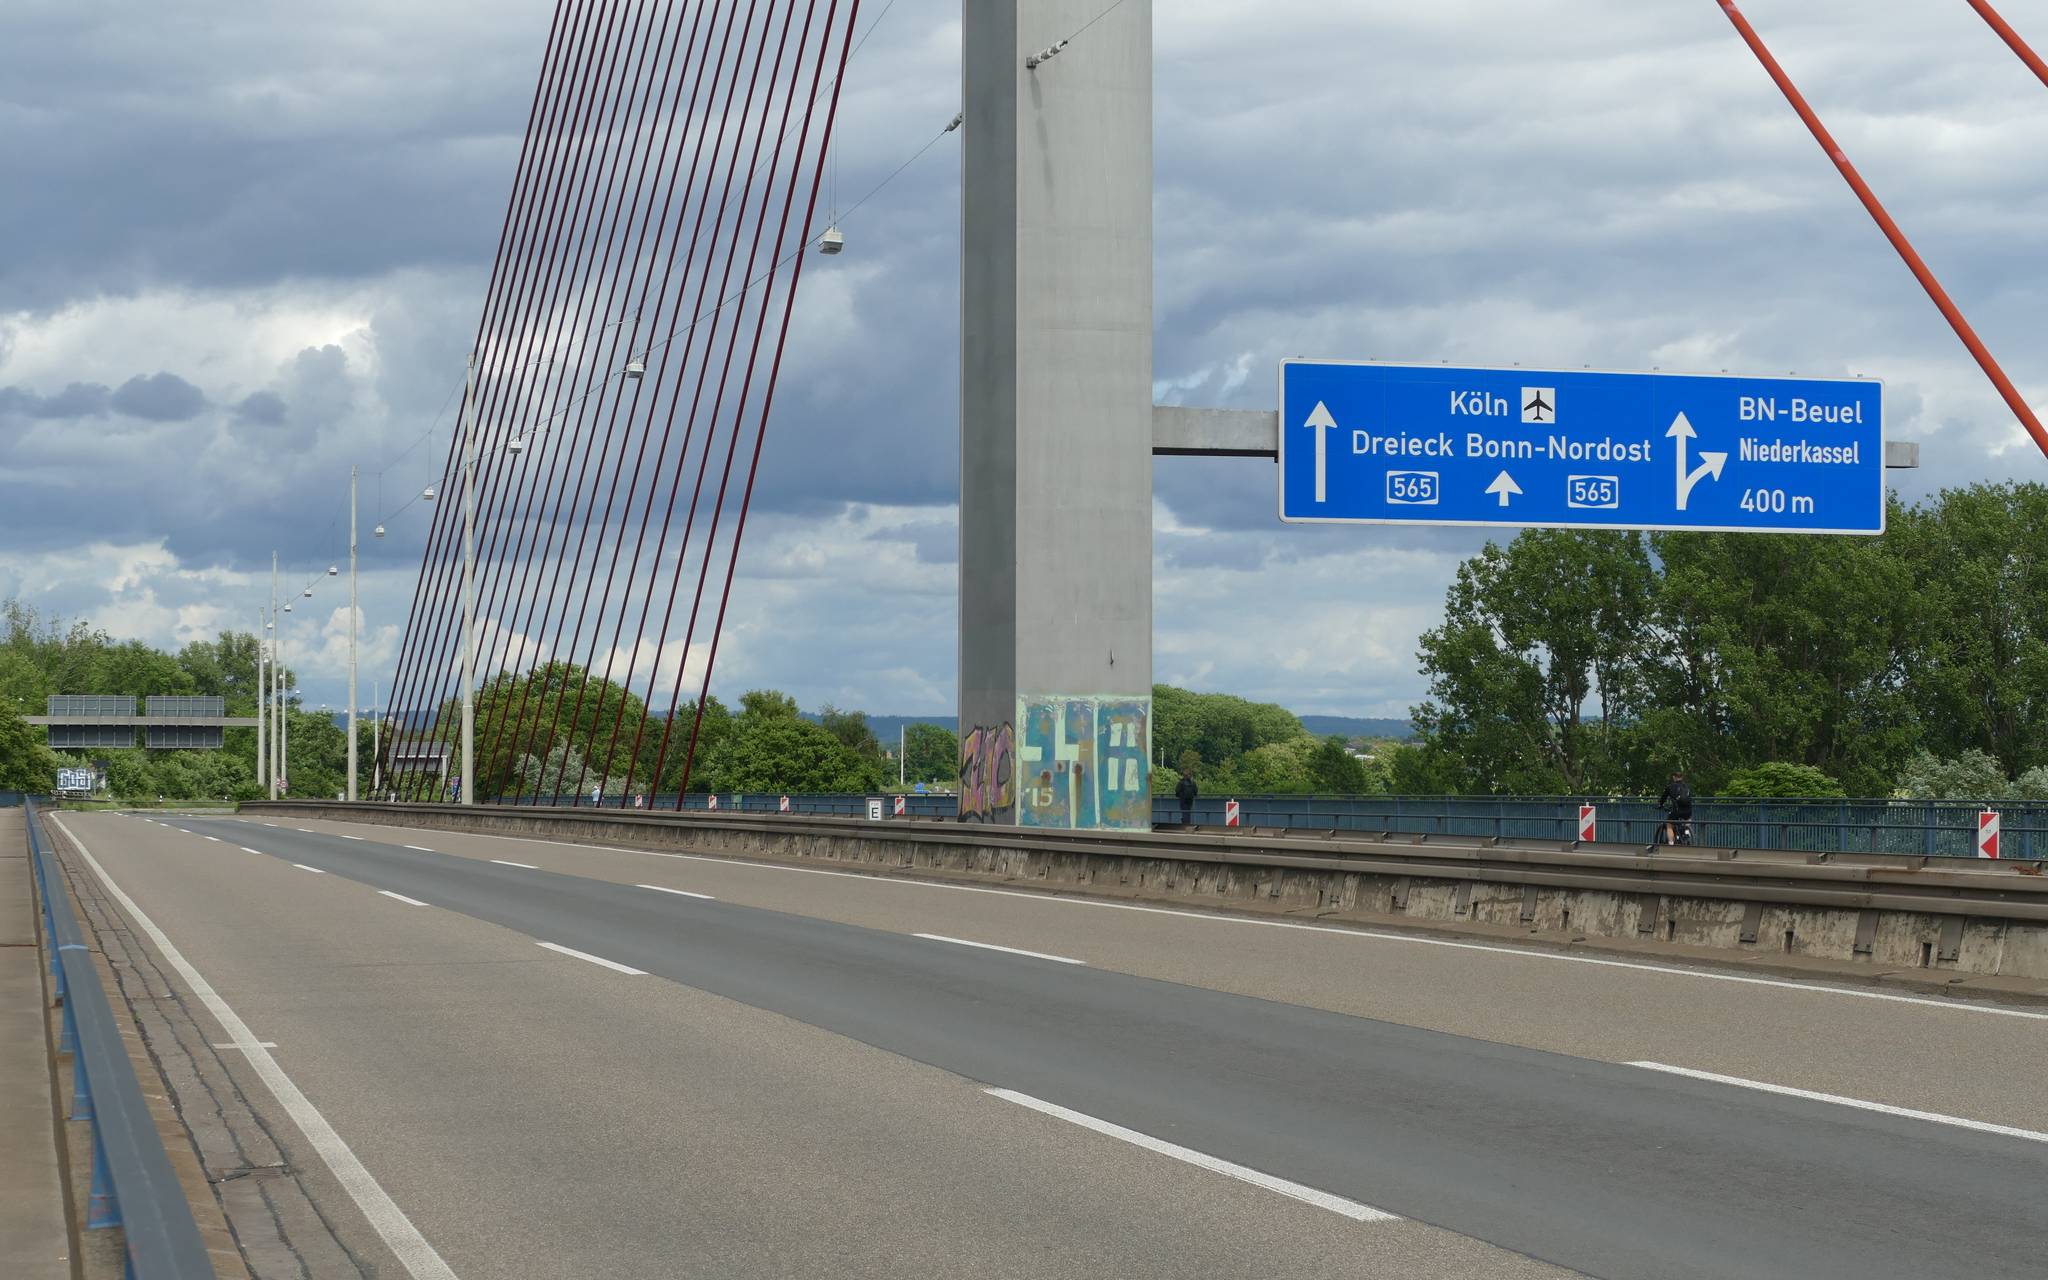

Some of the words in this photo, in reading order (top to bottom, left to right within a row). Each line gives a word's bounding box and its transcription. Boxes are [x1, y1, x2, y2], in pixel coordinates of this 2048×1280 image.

[1450, 390, 1508, 417] Köln
[1739, 396, 1863, 424] BN-Beuel
[1352, 430, 1454, 457] Dreieck
[1467, 433, 1651, 462] Bonn-Nordost
[1740, 437, 1860, 465] Niederkassel
[1394, 477, 1431, 498] 565
[1575, 481, 1611, 502] 565
[1740, 488, 1785, 513] 400
[1791, 496, 1814, 514] m
[871, 807, 879, 819] E
